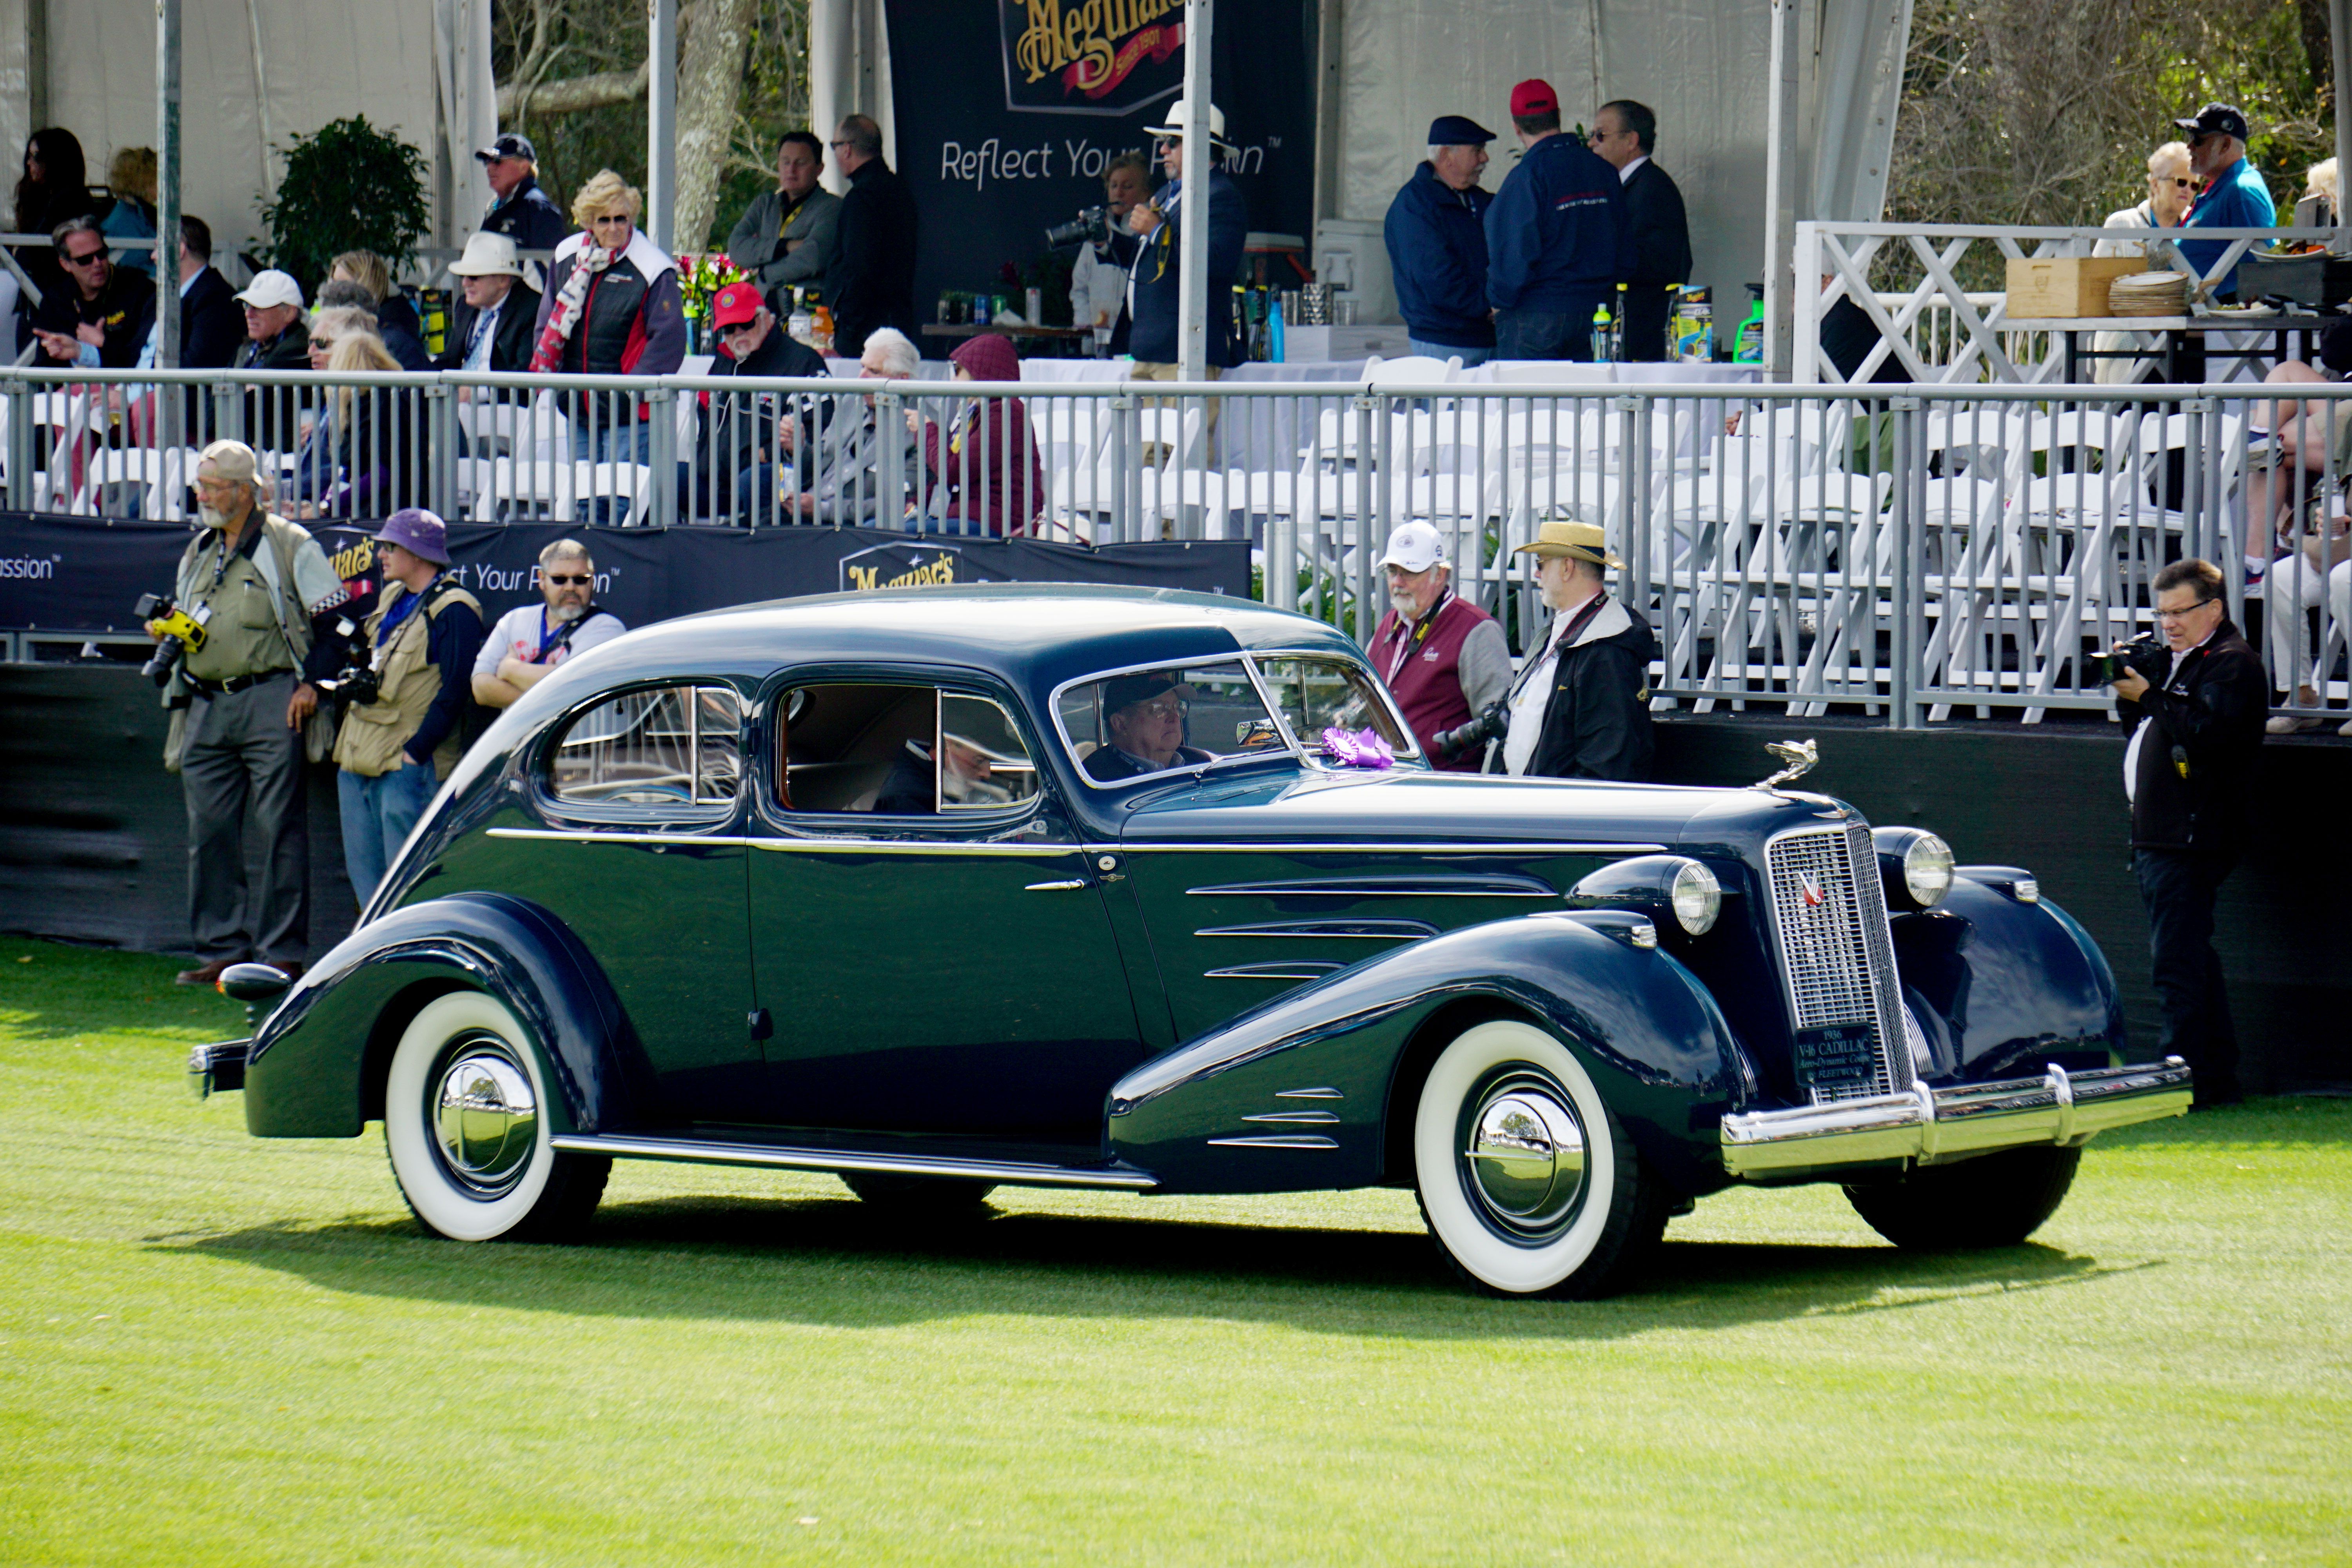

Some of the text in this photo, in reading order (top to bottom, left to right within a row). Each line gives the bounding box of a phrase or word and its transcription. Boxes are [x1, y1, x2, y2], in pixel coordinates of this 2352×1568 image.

[1116, 28, 1160, 76] Since 1901
[941, 138, 1053, 192] Reflect
[476, 563, 524, 591] Your
[1824, 1030, 1842, 1040] 1936
[1798, 1038, 1869, 1057] V-16 CADILLAC
[1819, 1066, 1863, 1078] FLEETWOOD
